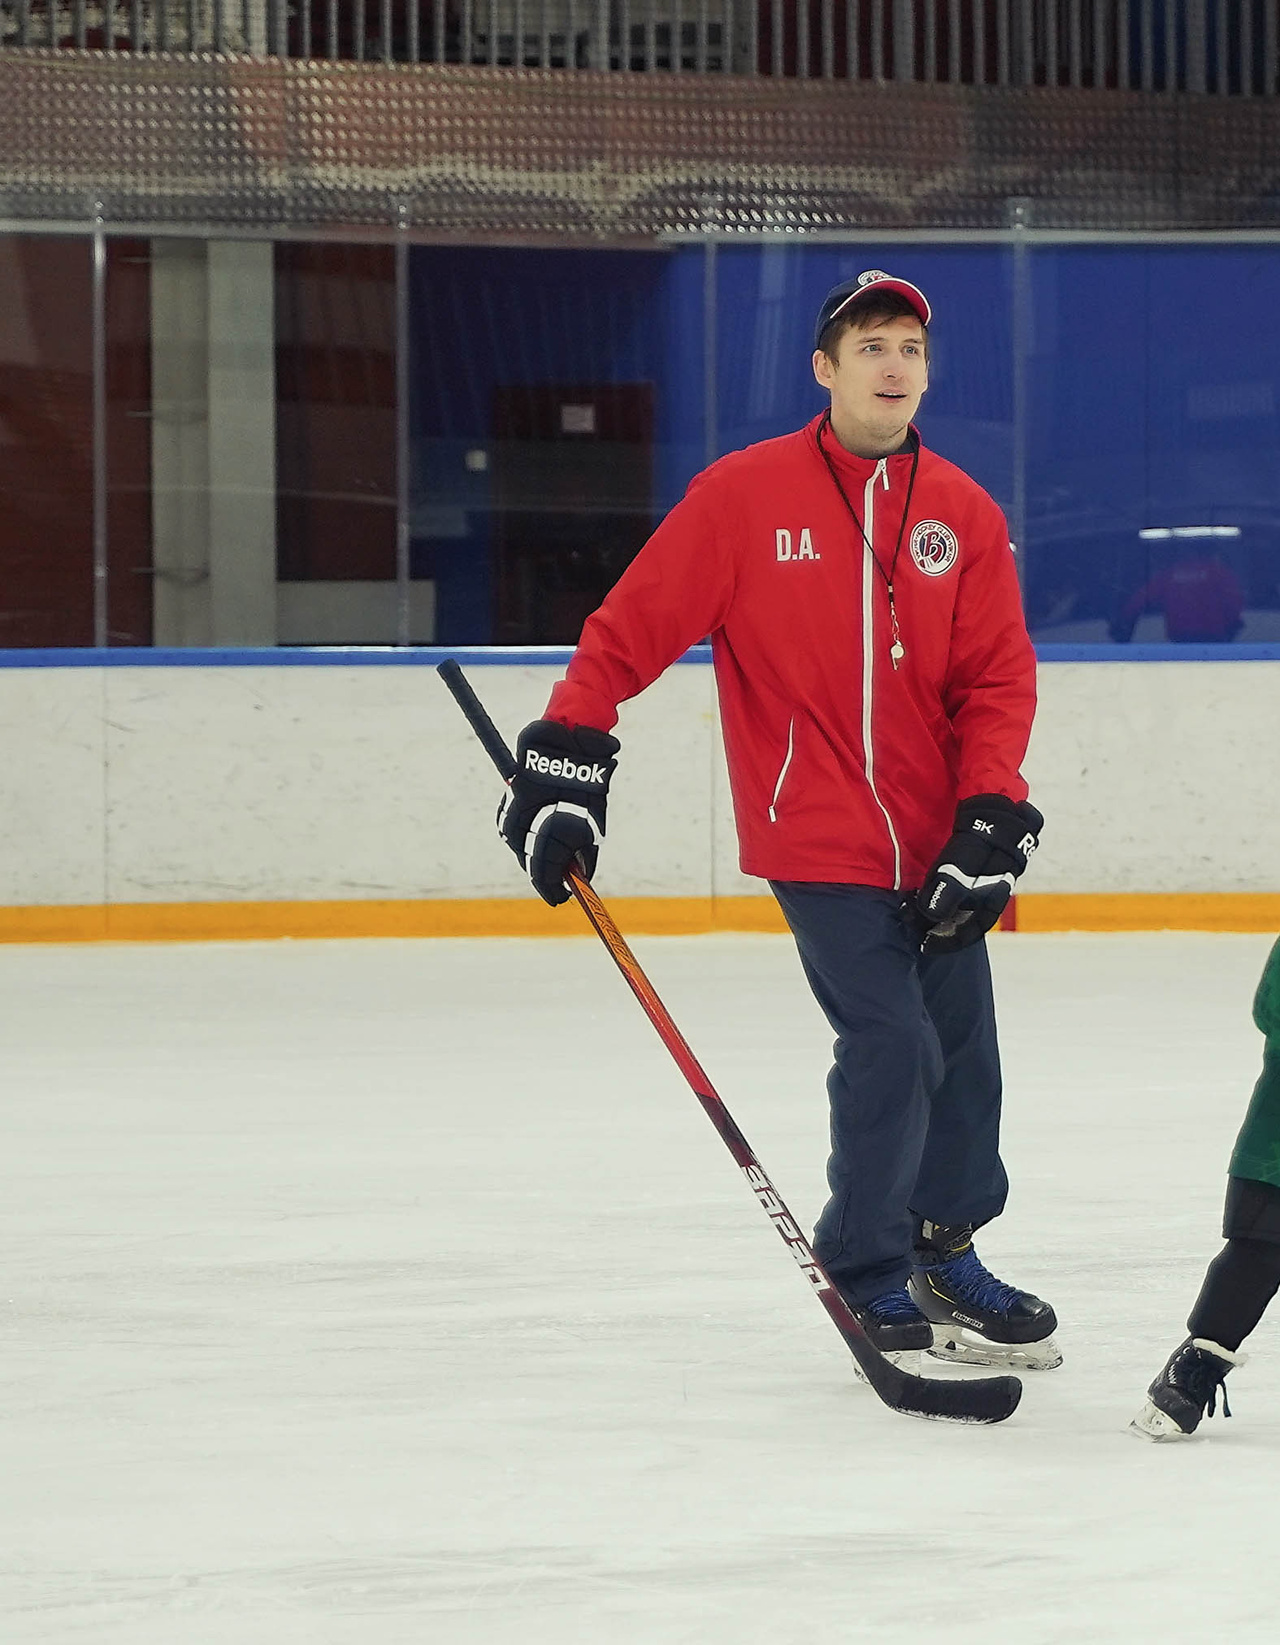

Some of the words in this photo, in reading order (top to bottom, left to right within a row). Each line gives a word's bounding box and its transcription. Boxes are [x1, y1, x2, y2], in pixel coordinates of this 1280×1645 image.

[776, 528, 820, 562] D.A.
[525, 750, 607, 784] Reebok
[929, 881, 947, 910] Reebok
